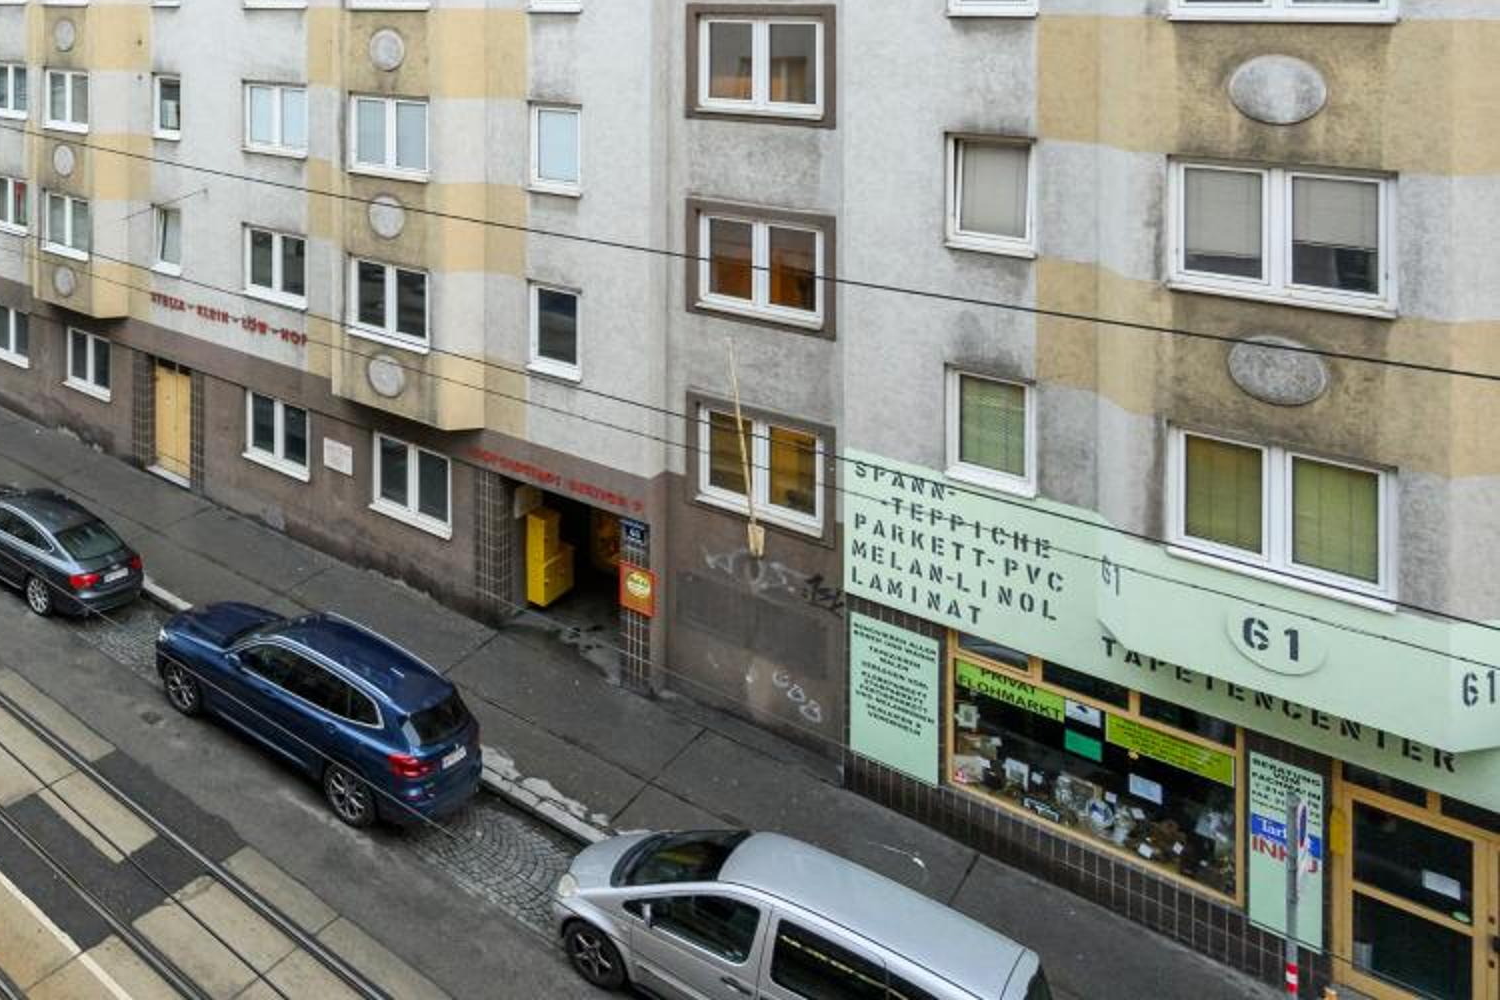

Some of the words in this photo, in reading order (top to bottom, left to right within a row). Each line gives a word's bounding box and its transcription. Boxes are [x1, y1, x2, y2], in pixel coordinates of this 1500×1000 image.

[855, 461, 955, 500] SPANN-
[851, 566, 981, 624] LAMINAT
[1101, 556, 1120, 595] 61
[1243, 616, 1298, 661] 61
[958, 674, 1062, 721] FLOHMARKT
[980, 668, 1038, 695] PRIVAT
[1463, 670, 1496, 706] 61
